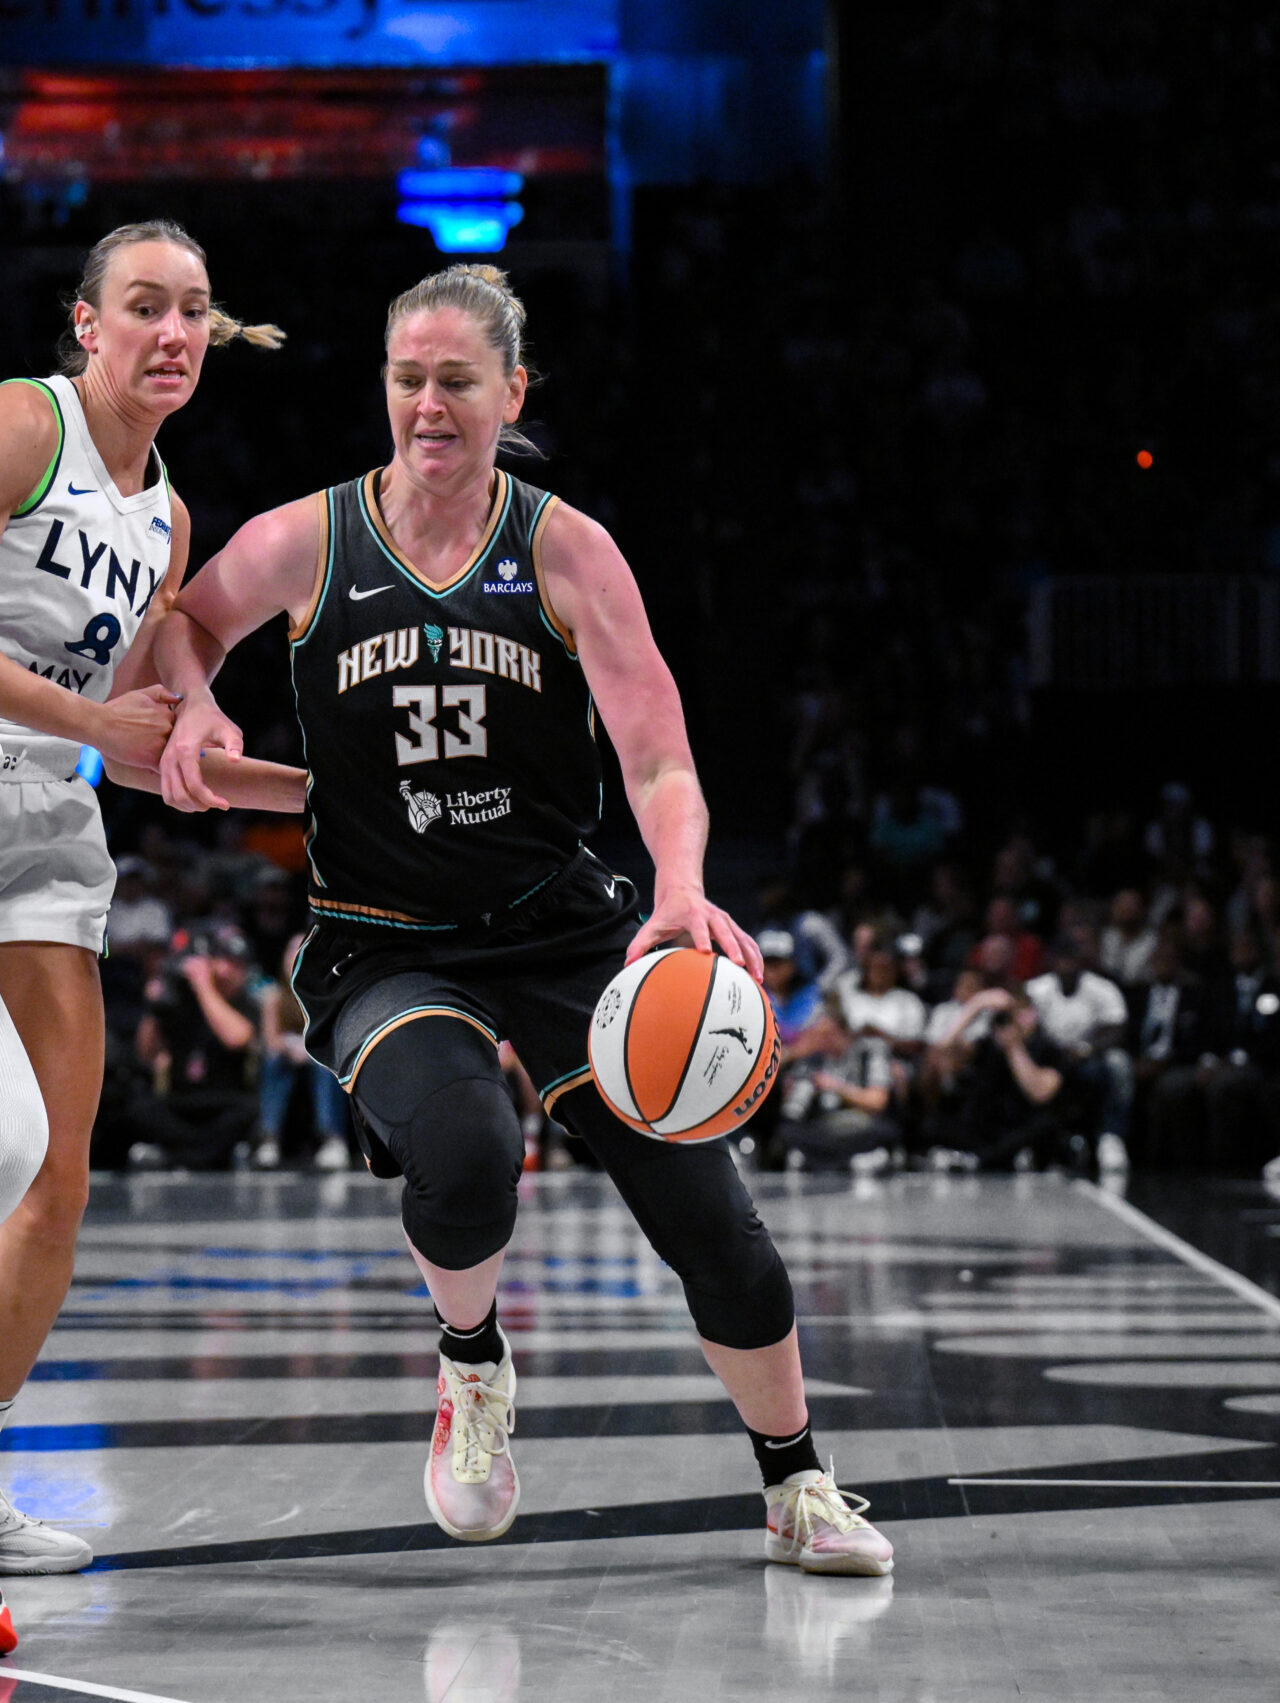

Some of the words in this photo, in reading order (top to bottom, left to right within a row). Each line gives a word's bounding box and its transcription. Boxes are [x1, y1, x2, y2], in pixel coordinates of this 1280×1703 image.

[35, 518, 163, 618] LYNX
[483, 582, 534, 594] BARCLAYS
[64, 612, 121, 666] 8
[337, 626, 420, 695] NEW
[447, 626, 542, 694] YORK
[392, 684, 488, 767] 33
[445, 787, 512, 807] Liberty
[450, 798, 512, 825] Mutual
